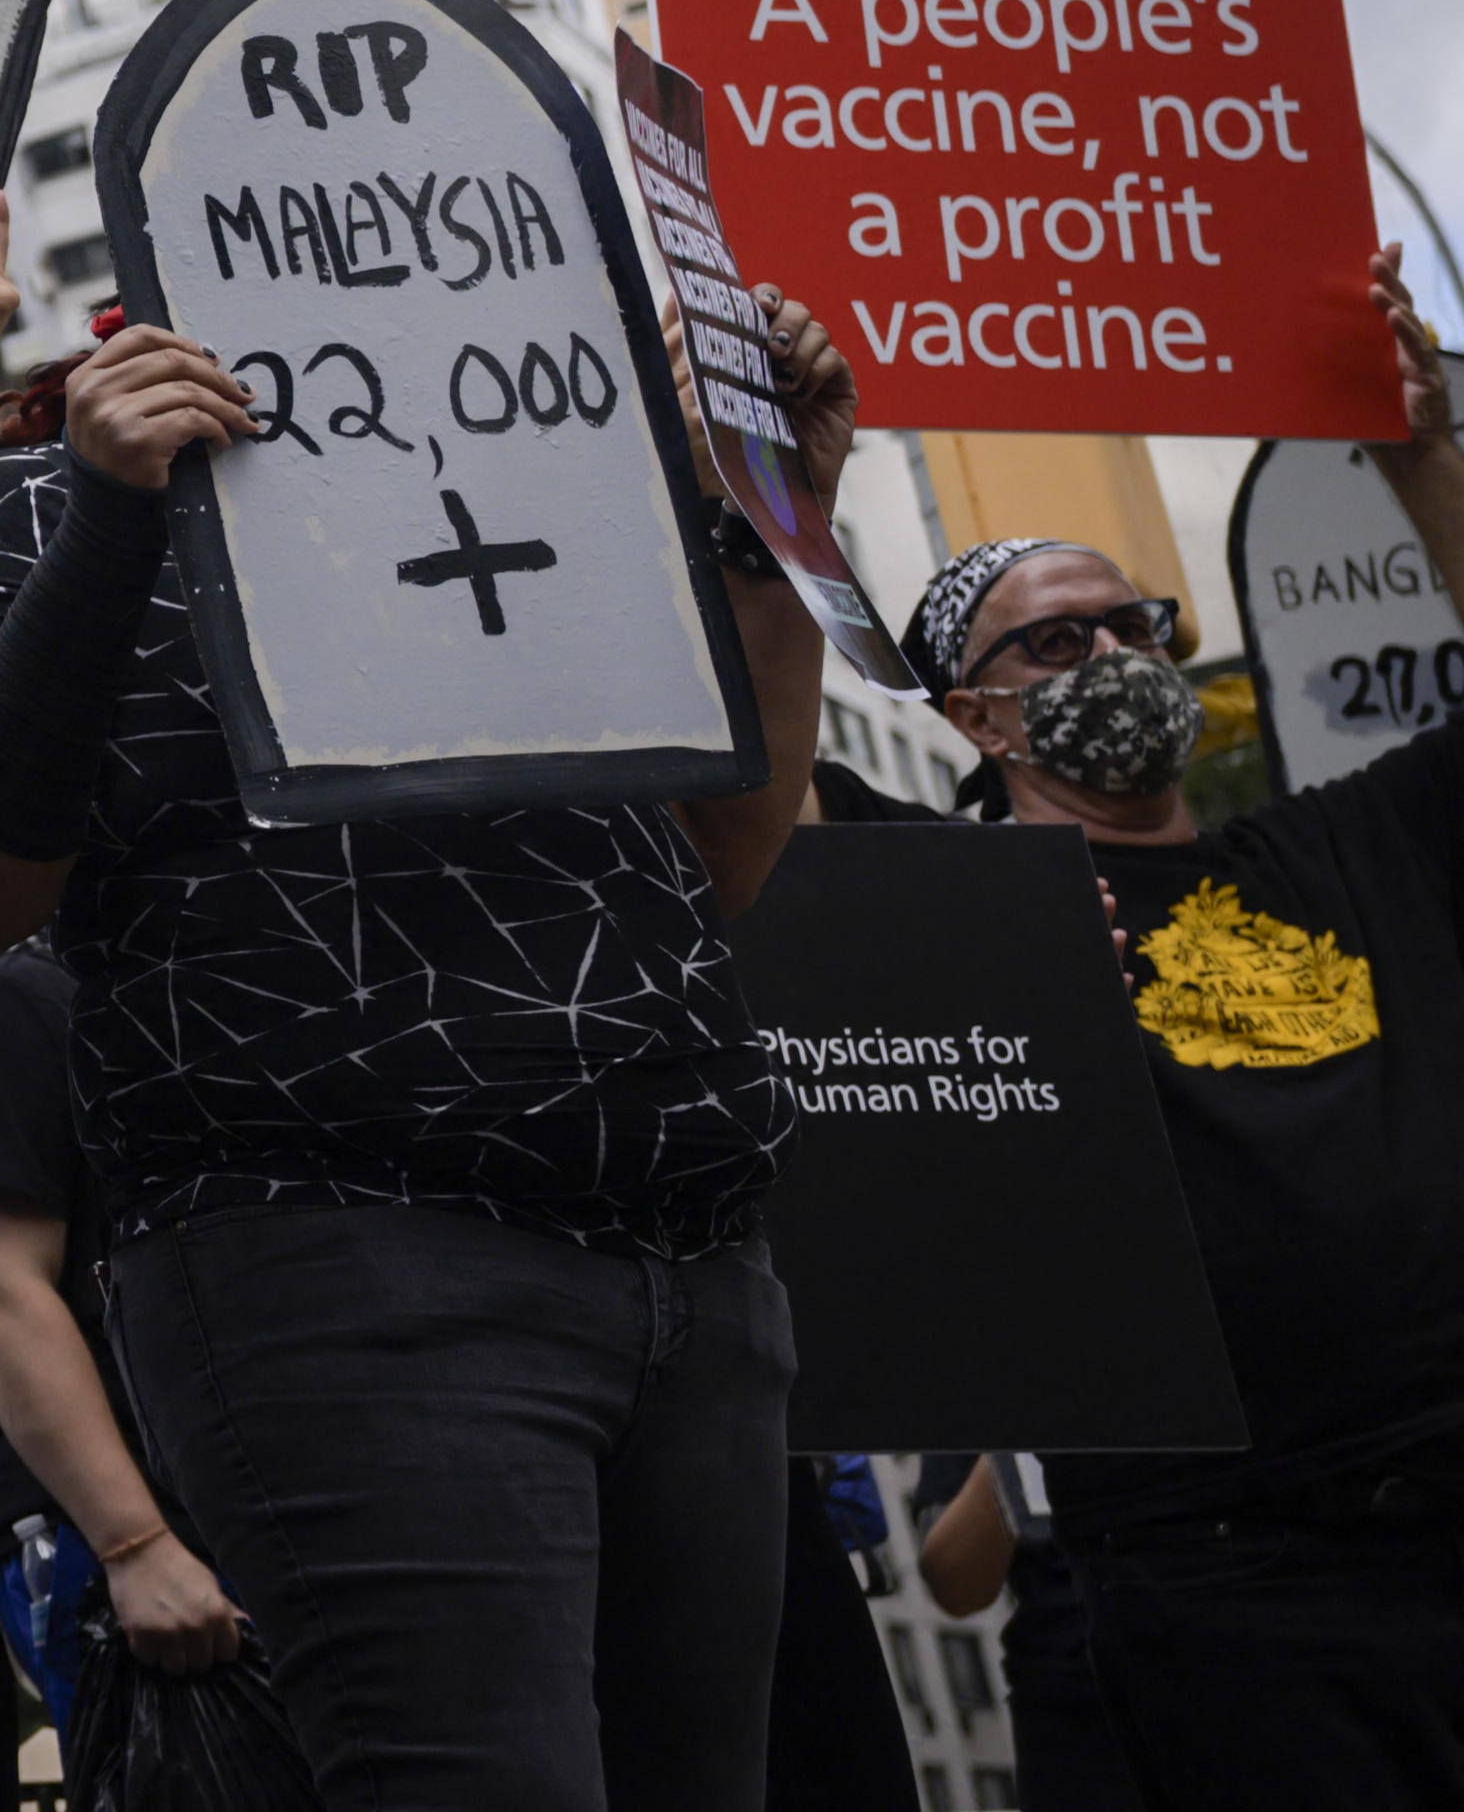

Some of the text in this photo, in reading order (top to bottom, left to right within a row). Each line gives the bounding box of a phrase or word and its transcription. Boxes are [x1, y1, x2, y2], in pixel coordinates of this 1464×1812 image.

[240, 20, 429, 130] RIP
[723, 65, 1308, 172] vaccine, not
[625, 99, 669, 170] VACCINES
[204, 170, 566, 294] MALAYSIA
[847, 173, 1221, 282] a profit
[852, 280, 1233, 374] vaccine.
[233, 332, 619, 480] 22,000
[1272, 541, 1447, 612] BANGL
[756, 1022, 1030, 1077] Physicians for
[931, 1072, 1061, 1123] Rights
